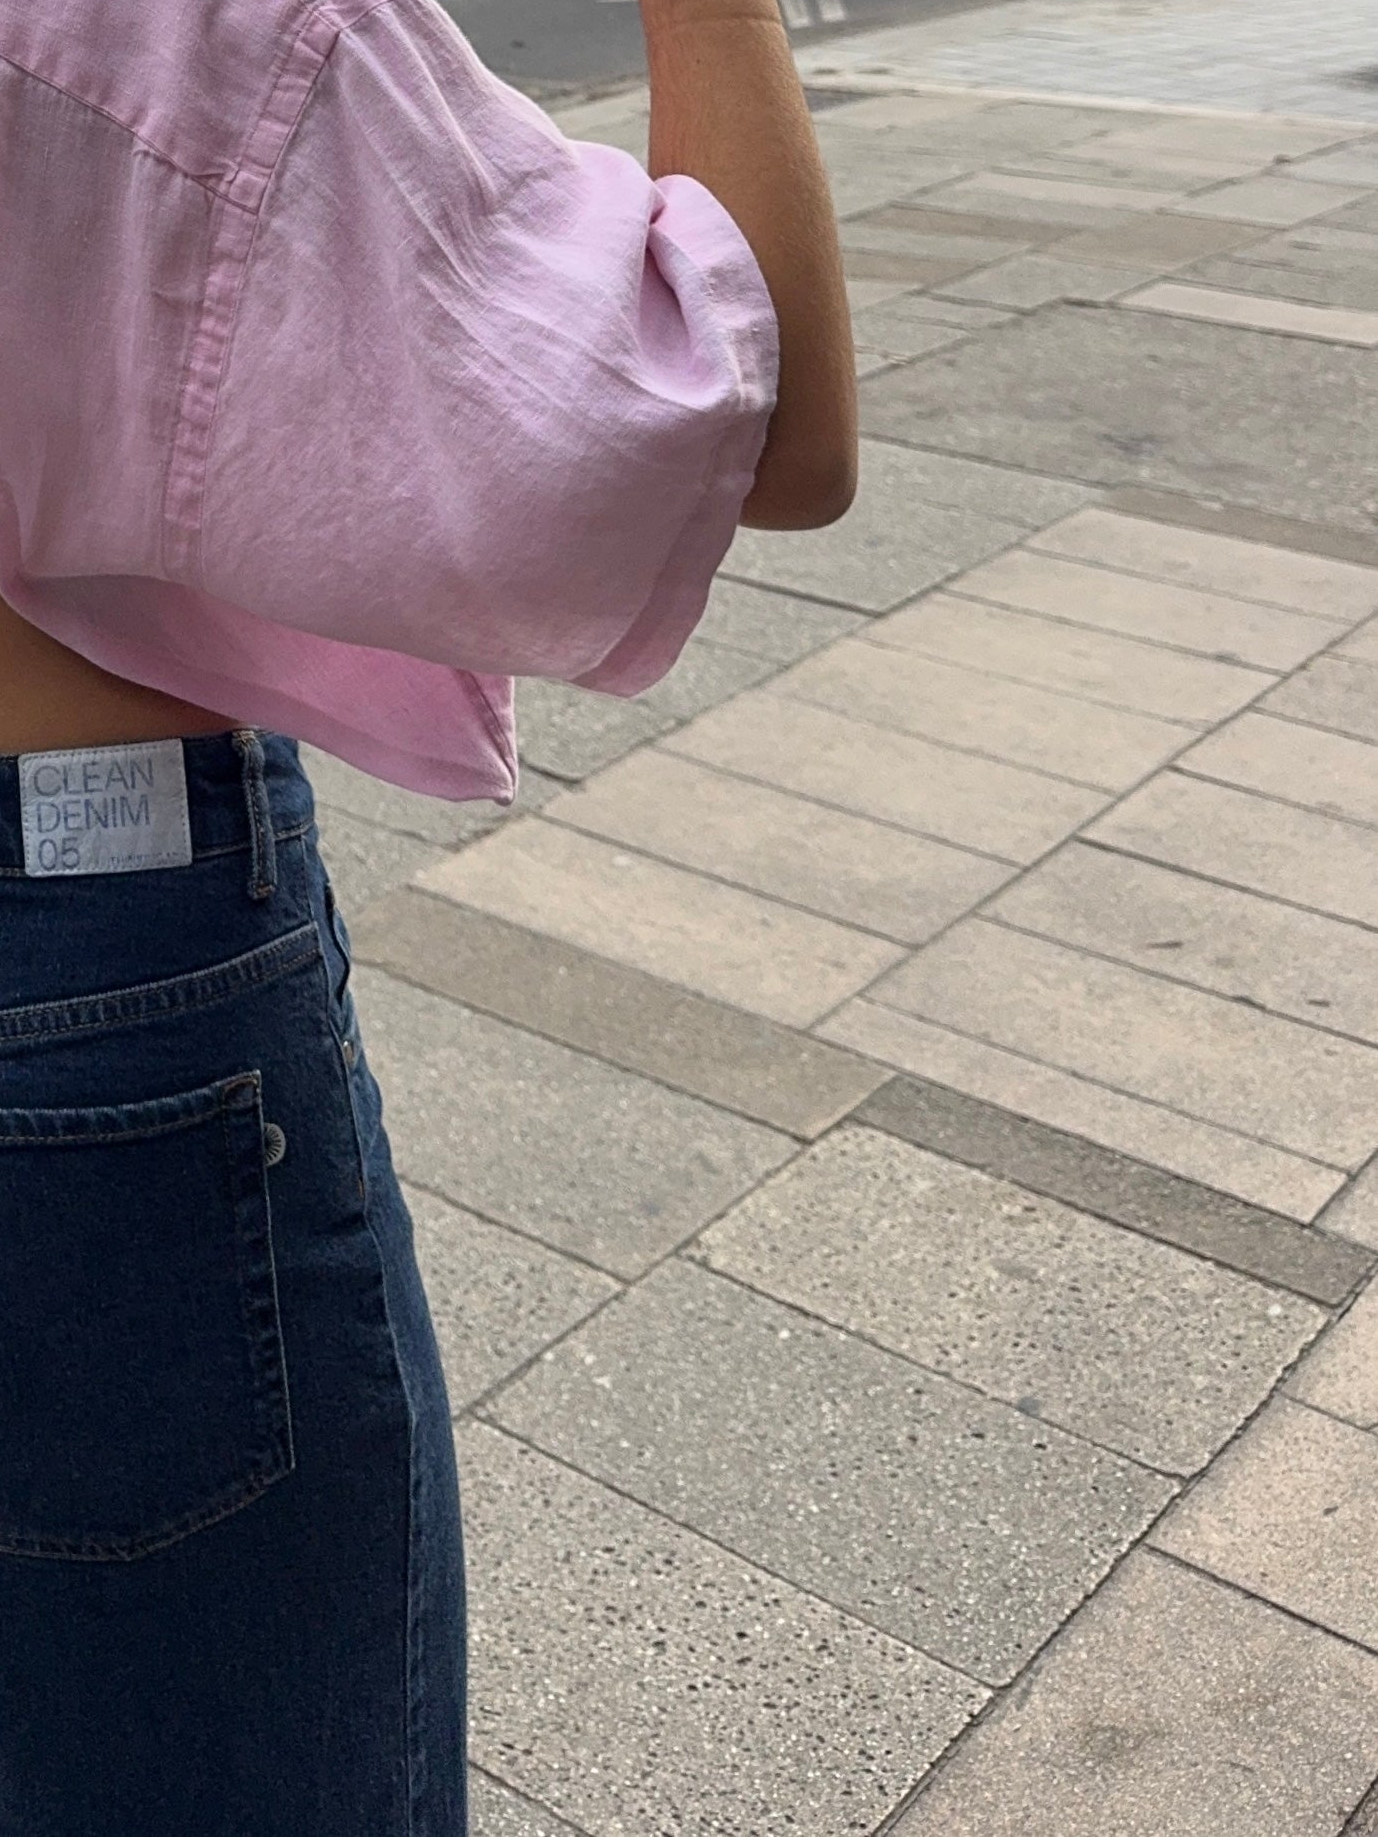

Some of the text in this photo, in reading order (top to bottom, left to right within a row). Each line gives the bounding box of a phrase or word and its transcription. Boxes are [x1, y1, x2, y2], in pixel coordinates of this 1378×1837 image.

[34, 759, 153, 796] CLEAN
[37, 796, 150, 833] DENIM
[38, 837, 81, 871] 05
